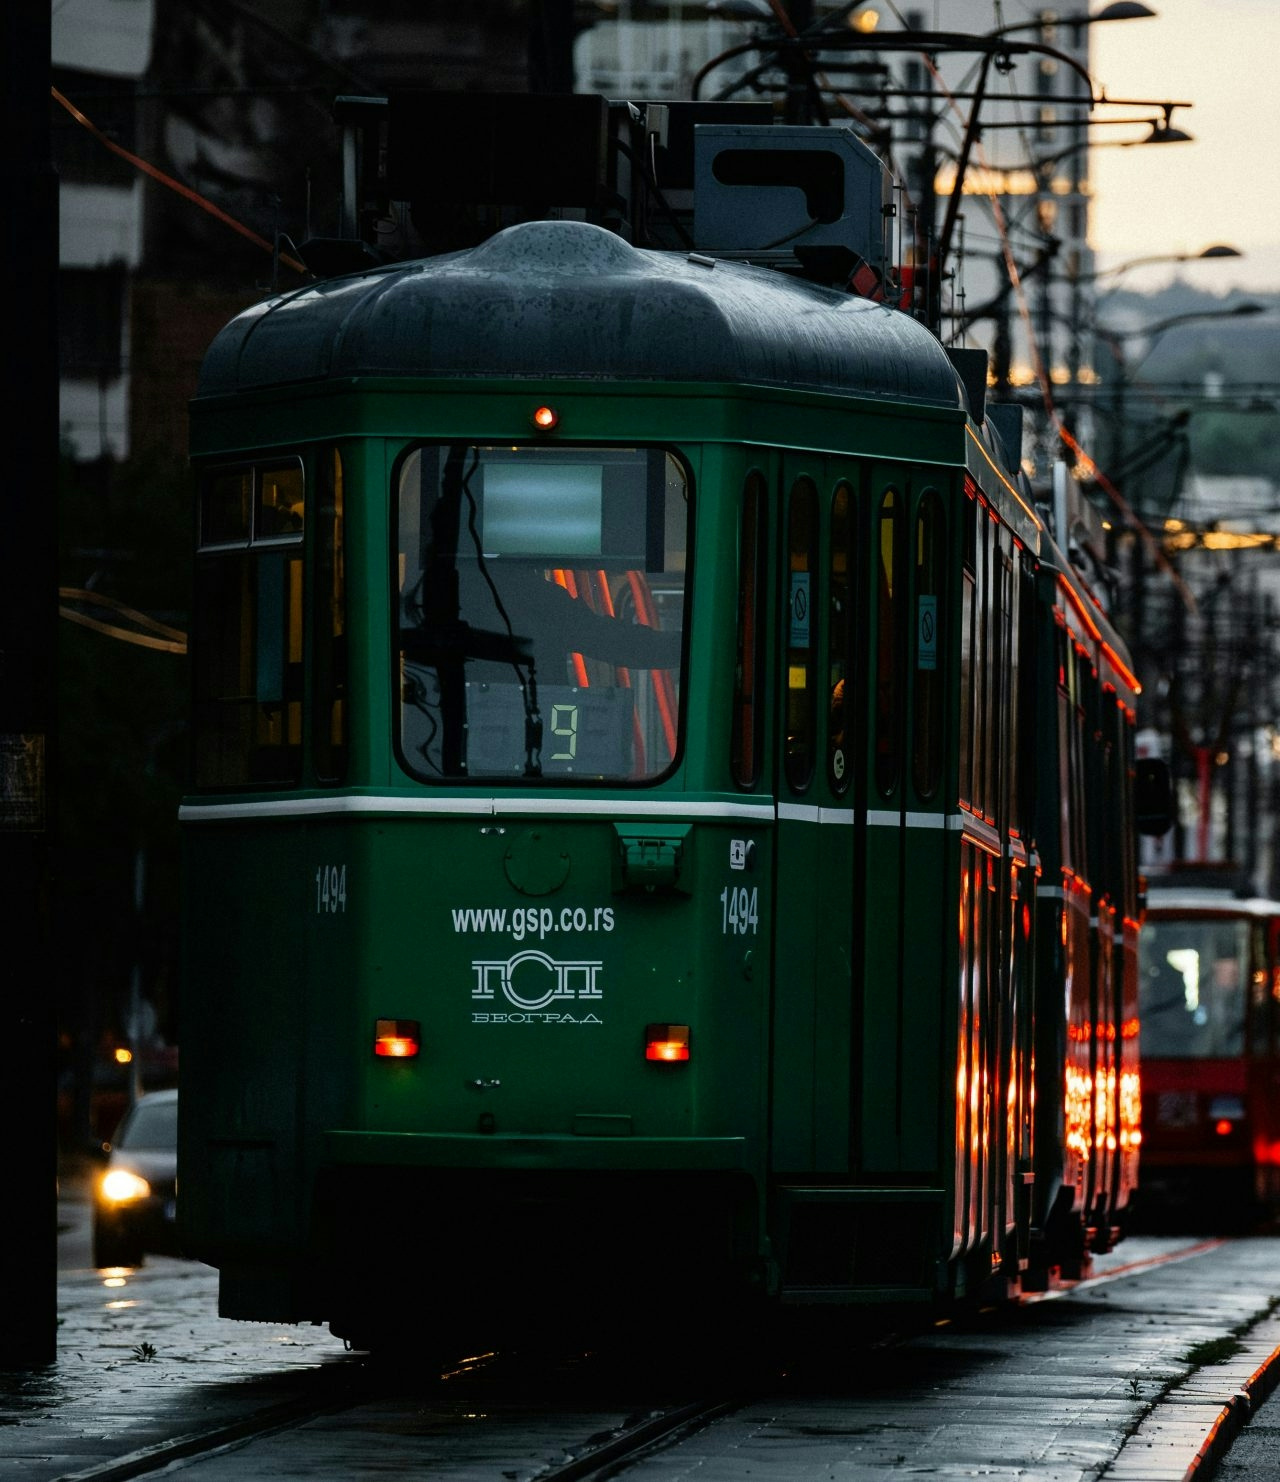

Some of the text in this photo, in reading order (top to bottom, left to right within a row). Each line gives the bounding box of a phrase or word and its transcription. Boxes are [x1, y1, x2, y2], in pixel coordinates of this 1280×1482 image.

[550, 704, 578, 760] 9
[315, 864, 348, 914] 1494
[720, 886, 759, 935] 1494
[451, 906, 615, 941] www.gsp.co.rs
[471, 1012, 604, 1025] БЕОГРАД
